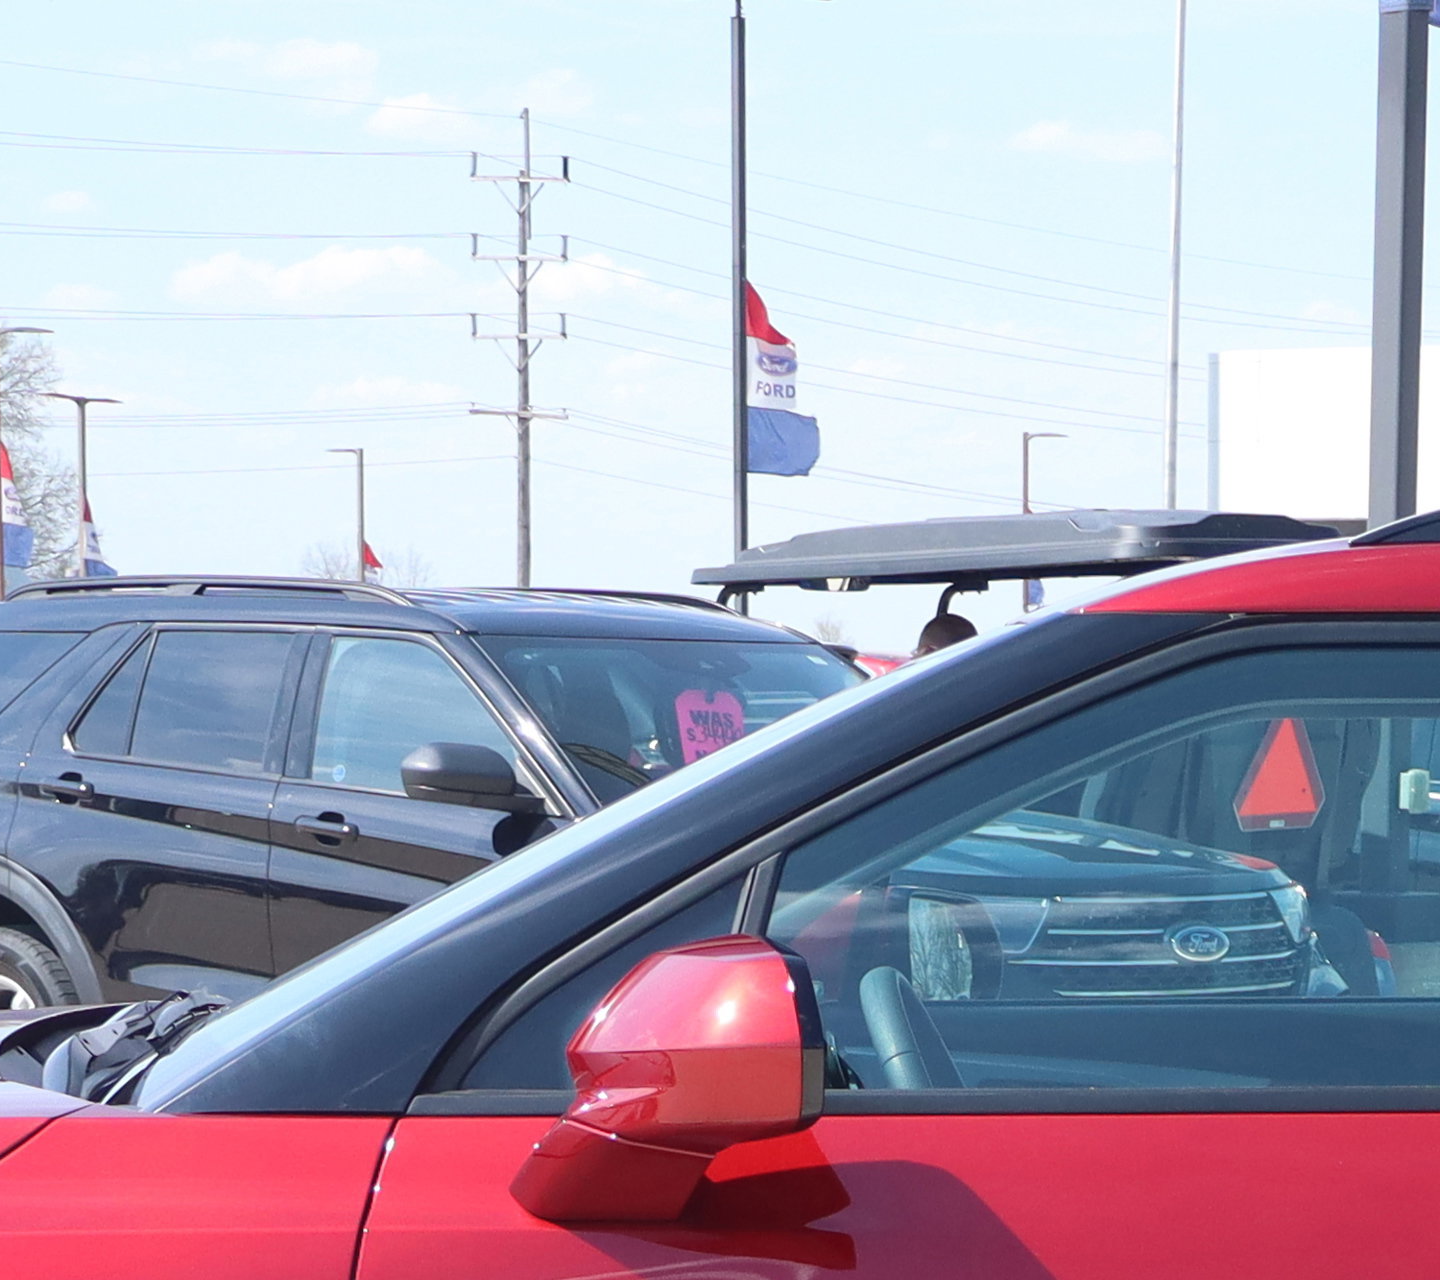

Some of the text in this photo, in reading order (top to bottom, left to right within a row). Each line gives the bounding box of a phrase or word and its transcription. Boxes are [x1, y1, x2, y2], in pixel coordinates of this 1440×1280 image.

[755, 381, 797, 399] FORD
[689, 710, 734, 729] WAS
[1188, 932, 1218, 953] Ford
